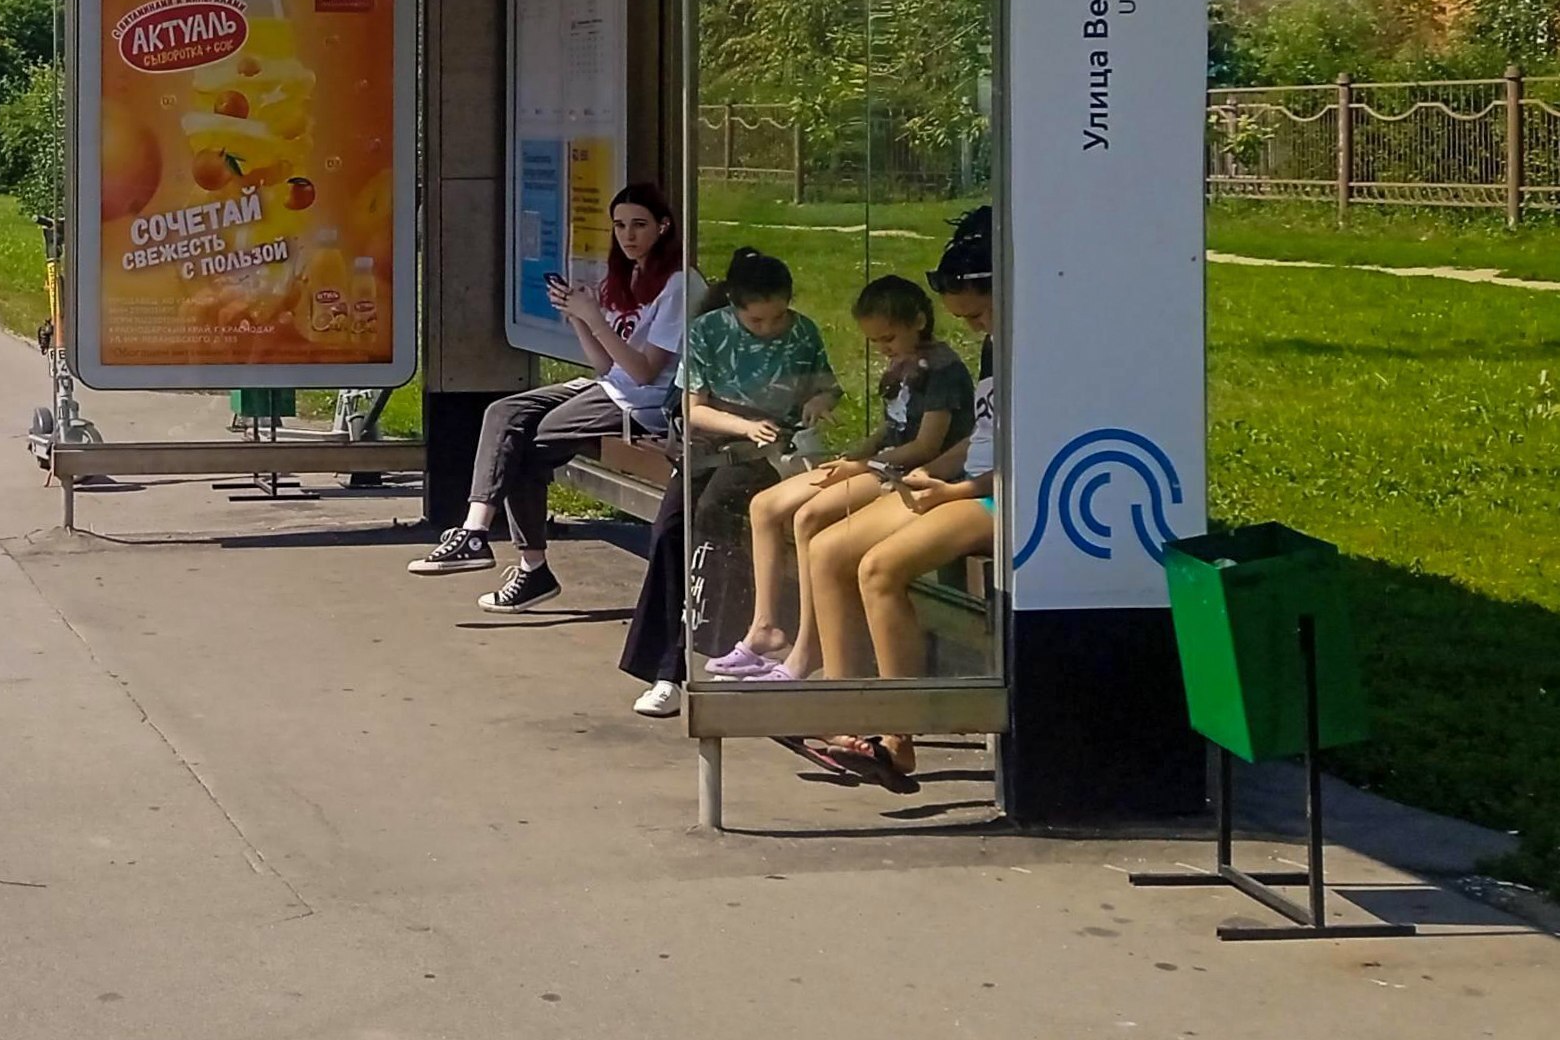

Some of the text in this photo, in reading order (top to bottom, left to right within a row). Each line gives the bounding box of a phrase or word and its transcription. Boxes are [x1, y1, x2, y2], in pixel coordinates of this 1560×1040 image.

[132, 11, 238, 55] АКТУАЛЬ
[143, 47, 203, 67] СЫВОРОТКА
[213, 39, 235, 53] СОК
[1083, 50, 1113, 151] Улица
[130, 185, 262, 246] СОЧЕТАЙ
[122, 233, 226, 270] СВЕЖЕСТЬ
[182, 236, 289, 279] С ПОЛЬЗОЙ
